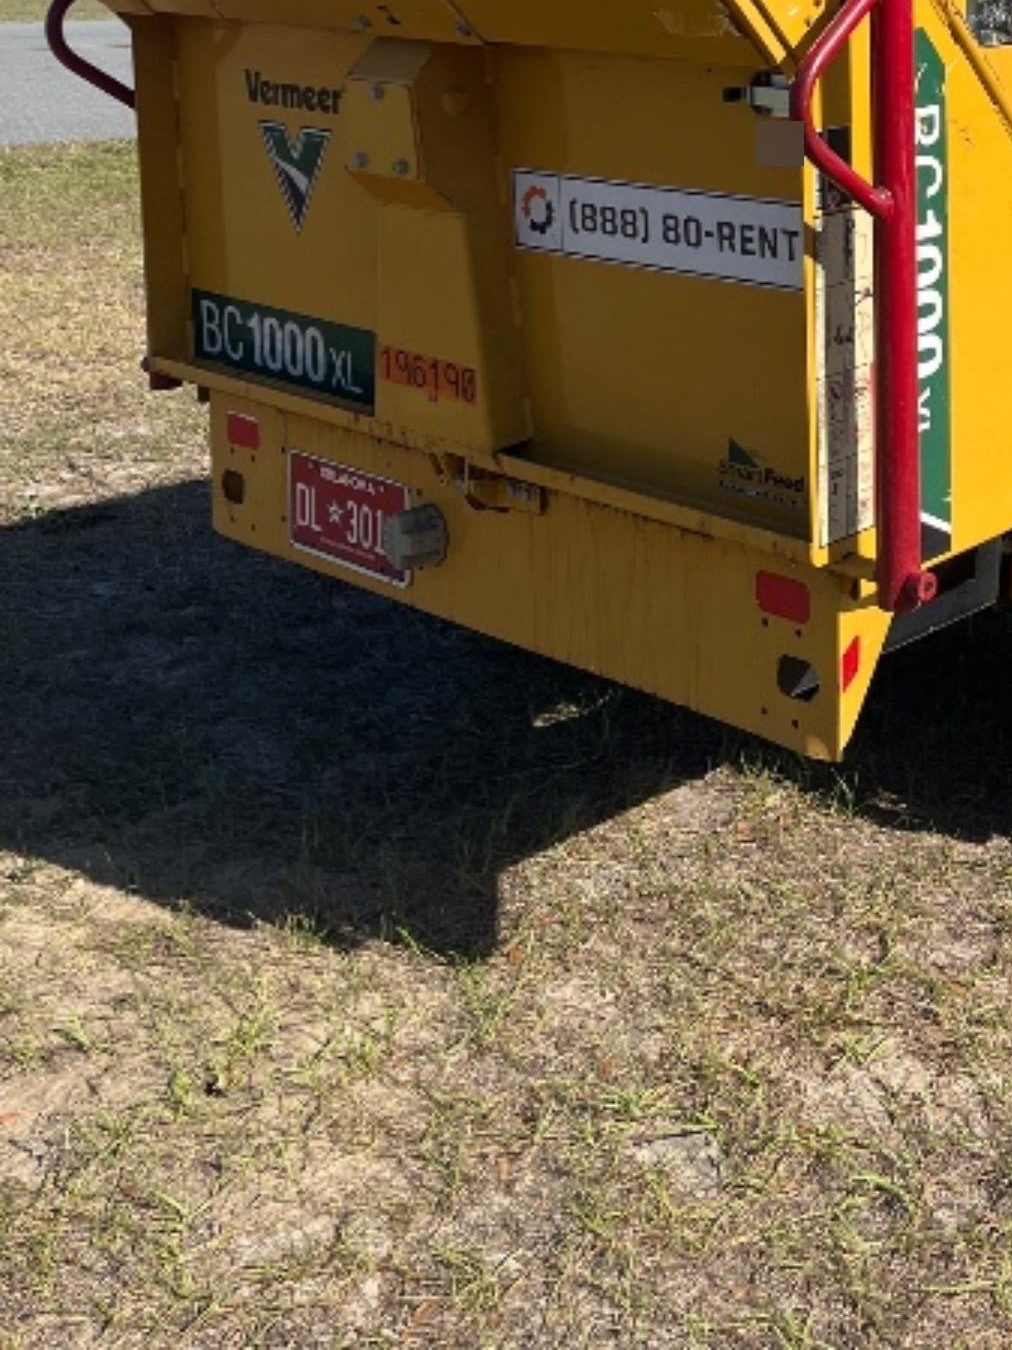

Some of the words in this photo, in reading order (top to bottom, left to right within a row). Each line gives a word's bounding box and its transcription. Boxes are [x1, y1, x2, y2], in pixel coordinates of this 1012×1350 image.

[244, 69, 345, 114] Vermeer
[569, 198, 649, 245] (888)
[663, 212, 801, 262] 80-RENT
[346, 500, 386, 556] 301
